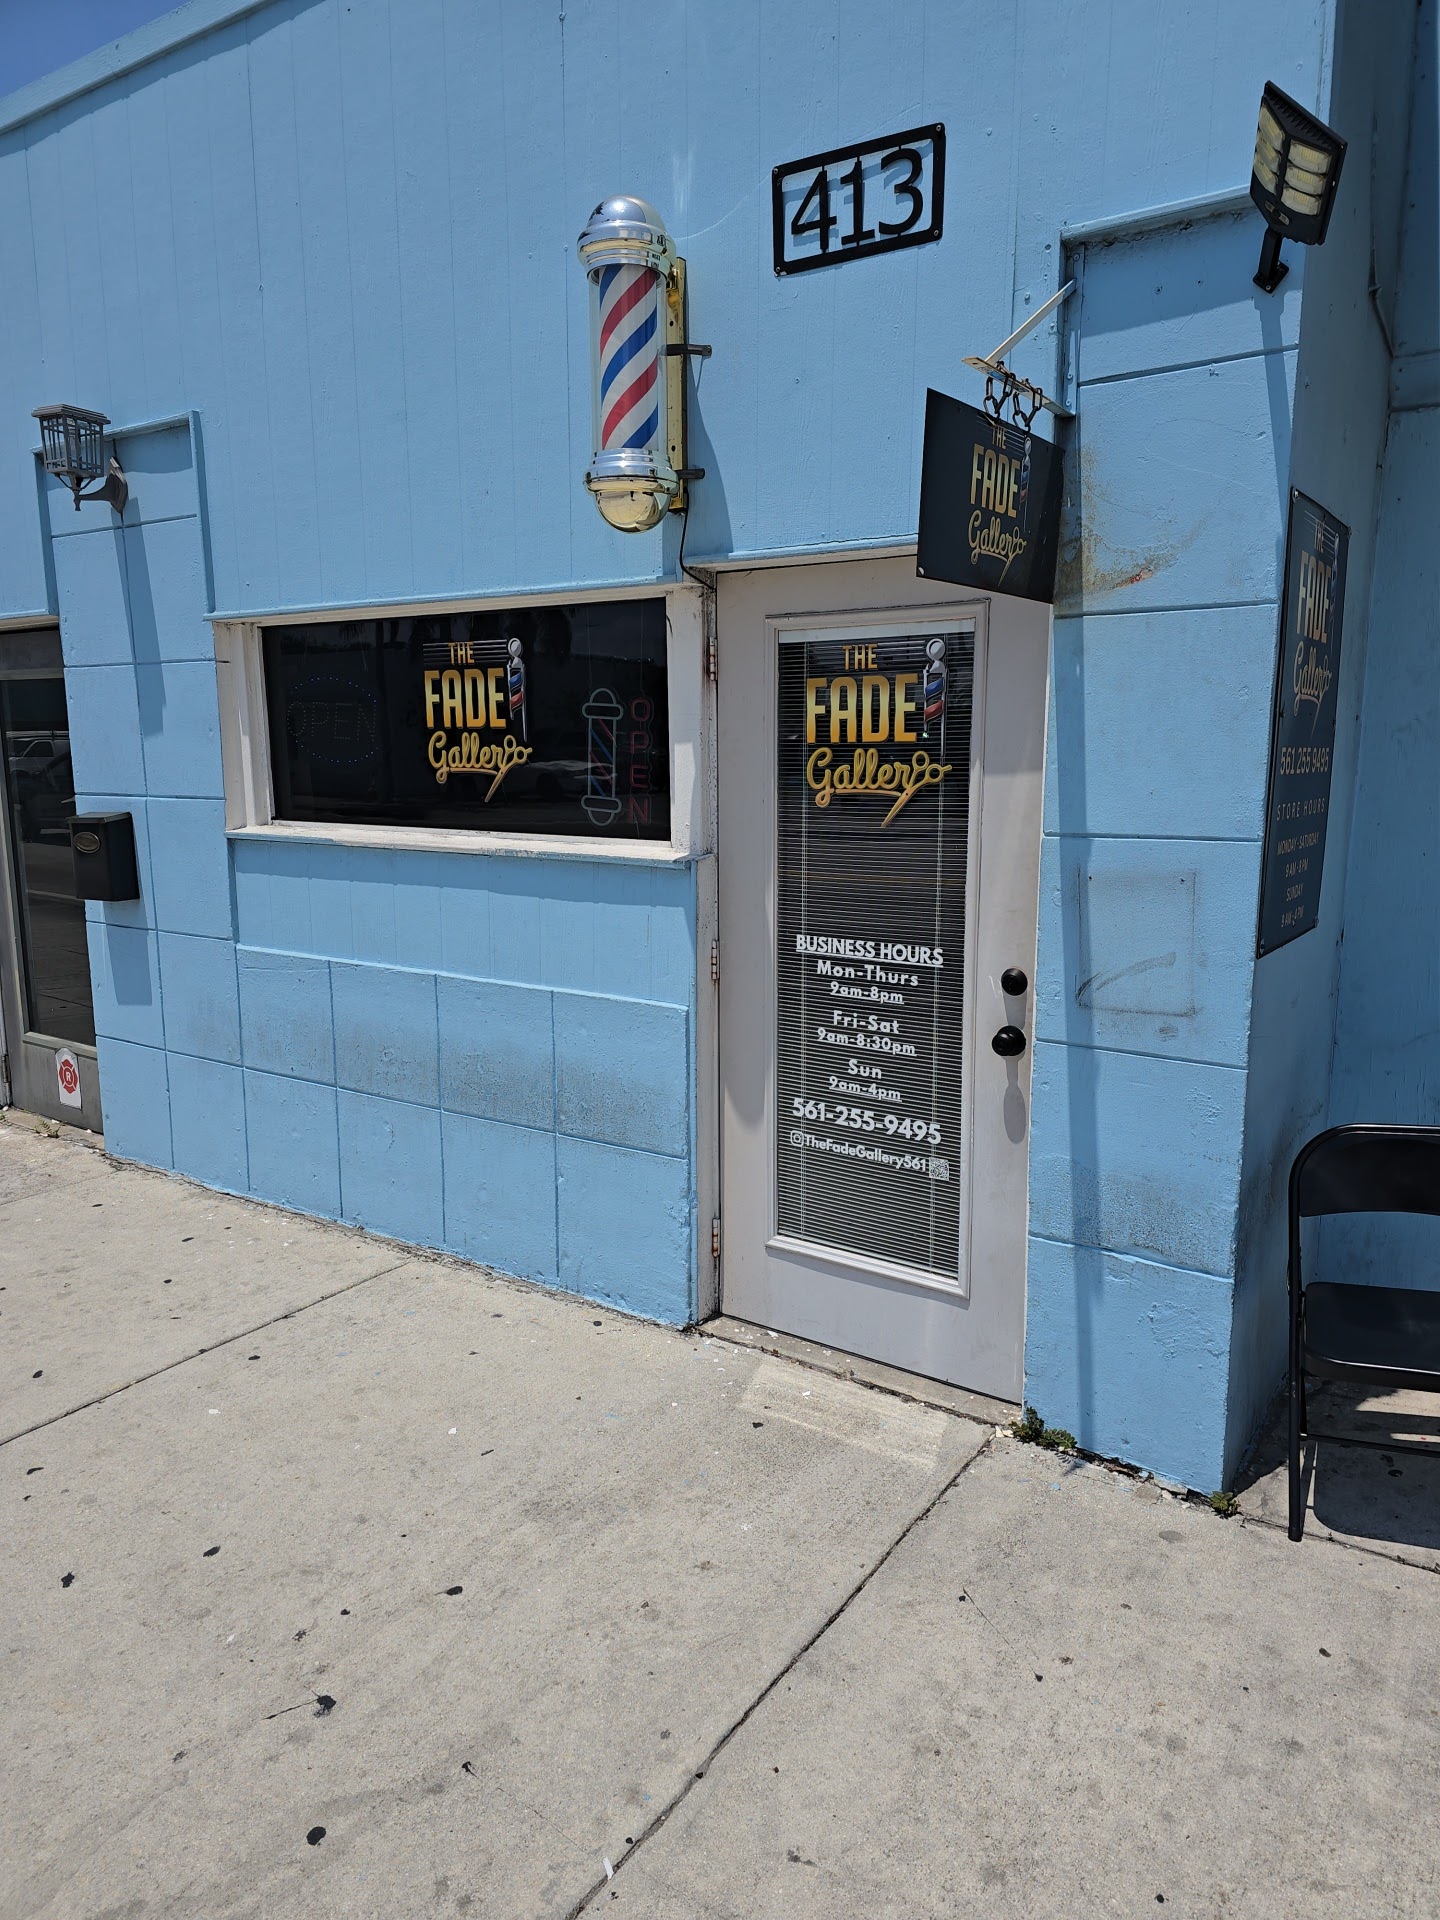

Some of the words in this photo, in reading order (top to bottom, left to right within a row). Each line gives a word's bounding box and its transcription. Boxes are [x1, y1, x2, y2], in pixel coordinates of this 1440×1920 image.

[791, 148, 923, 250] 413
[992, 424, 1007, 449] THE
[971, 444, 1021, 518] FADE
[968, 510, 1027, 586] Gallery
[1314, 518, 1325, 553] THE
[1297, 550, 1332, 644] FADE
[448, 642, 475, 665] THE
[842, 644, 878, 670] THE
[424, 668, 507, 729] FADE
[1293, 640, 1332, 738] Gallery
[287, 700, 376, 741] OPEN
[806, 673, 919, 744] FADE
[428, 731, 533, 803] Gallery
[627, 698, 651, 824] OPEN
[1280, 747, 1296, 775] 561
[1296, 747, 1311, 774] 255
[1311, 747, 1329, 773] 9495
[806, 747, 952, 828] Gallery
[1276, 801, 1301, 821] STORE
[1303, 797, 1325, 816] HOURS
[1286, 883, 1304, 901] SUNDAY
[796, 934, 876, 958] BUSINESS
[880, 942, 944, 965] HOURS
[816, 960, 919, 986] Mon-Thurs
[830, 981, 904, 1003] 9am-8pm
[833, 1010, 900, 1034] Fri-Sat
[817, 1028, 917, 1055] 9am-8:30pm
[65, 1071, 72, 1082] R
[848, 1059, 882, 1079] Sun
[829, 1076, 902, 1101] 9am-4pm
[792, 1097, 942, 1145] 561-255-9495
